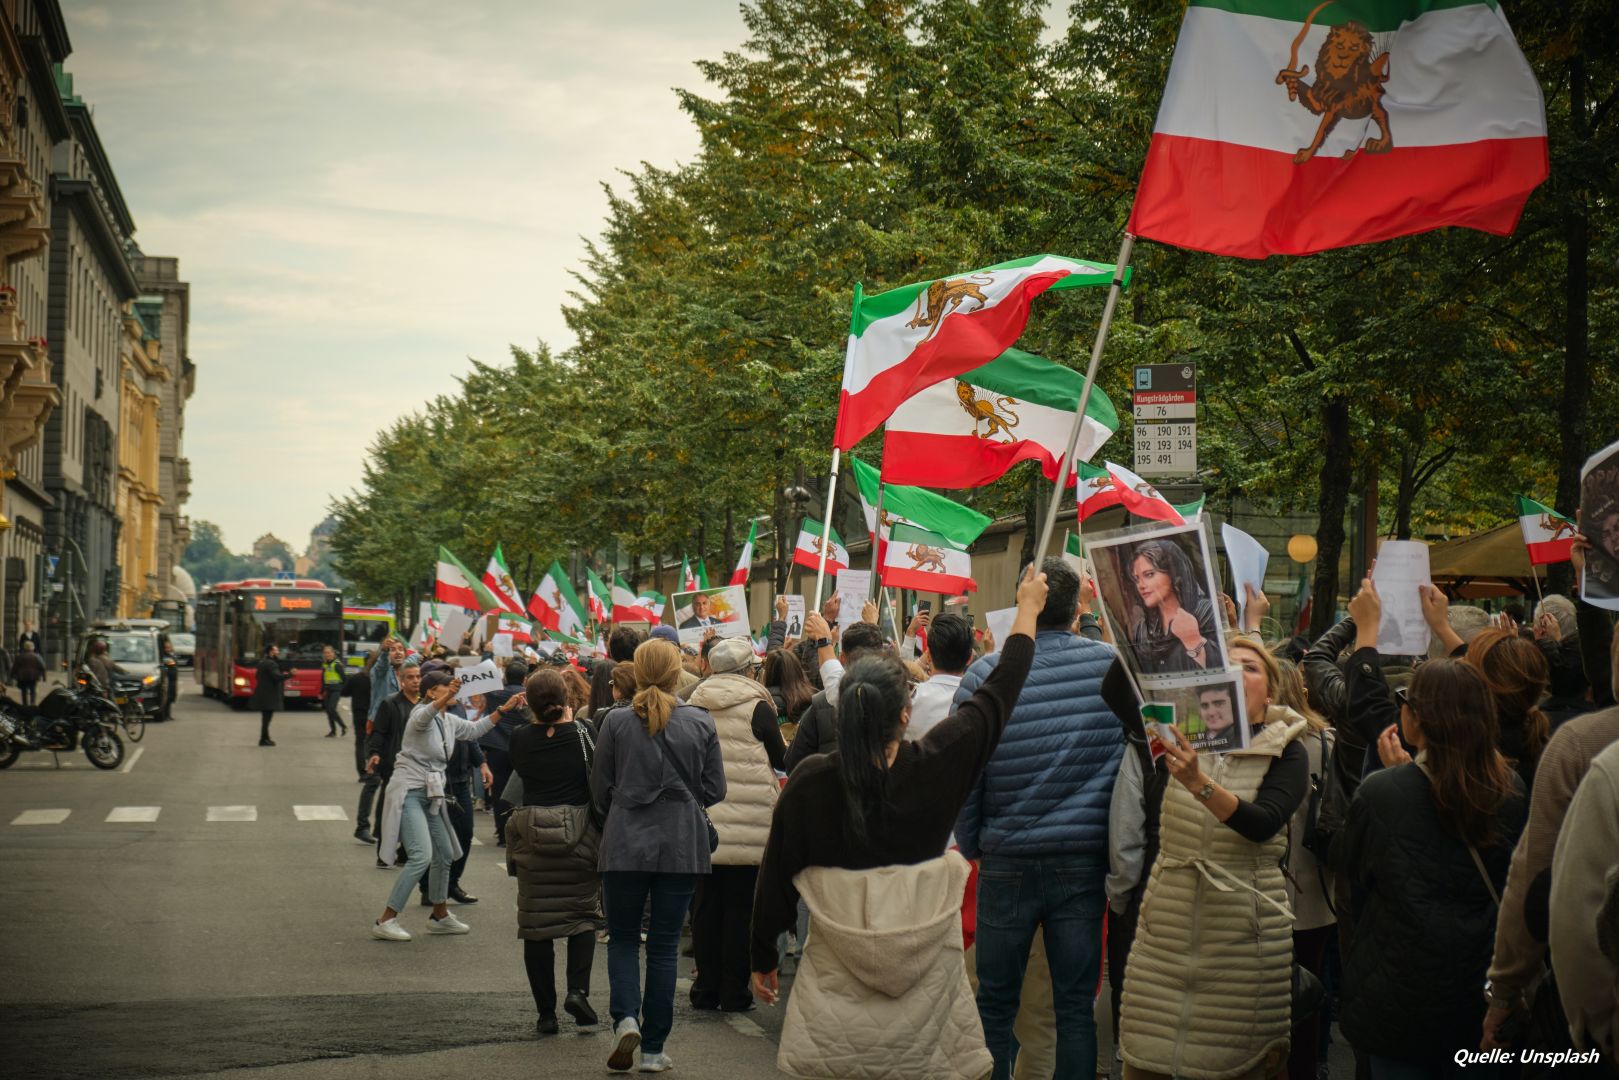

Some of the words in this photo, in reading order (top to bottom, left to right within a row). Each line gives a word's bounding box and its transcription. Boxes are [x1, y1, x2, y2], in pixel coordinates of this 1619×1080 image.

[1136, 394, 1184, 404] Kungsträdgården
[1136, 407, 1142, 416] 2
[1156, 406, 1167, 416] 76
[1136, 427, 1147, 437] 96
[1157, 426, 1171, 436] 190
[1178, 426, 1191, 436] 191
[1137, 441, 1151, 451] 192
[1157, 440, 1171, 450] 193
[1178, 440, 1192, 450] 194
[1137, 455, 1151, 465] 195
[1157, 454, 1172, 464] 491
[460, 671, 494, 684] RAN
